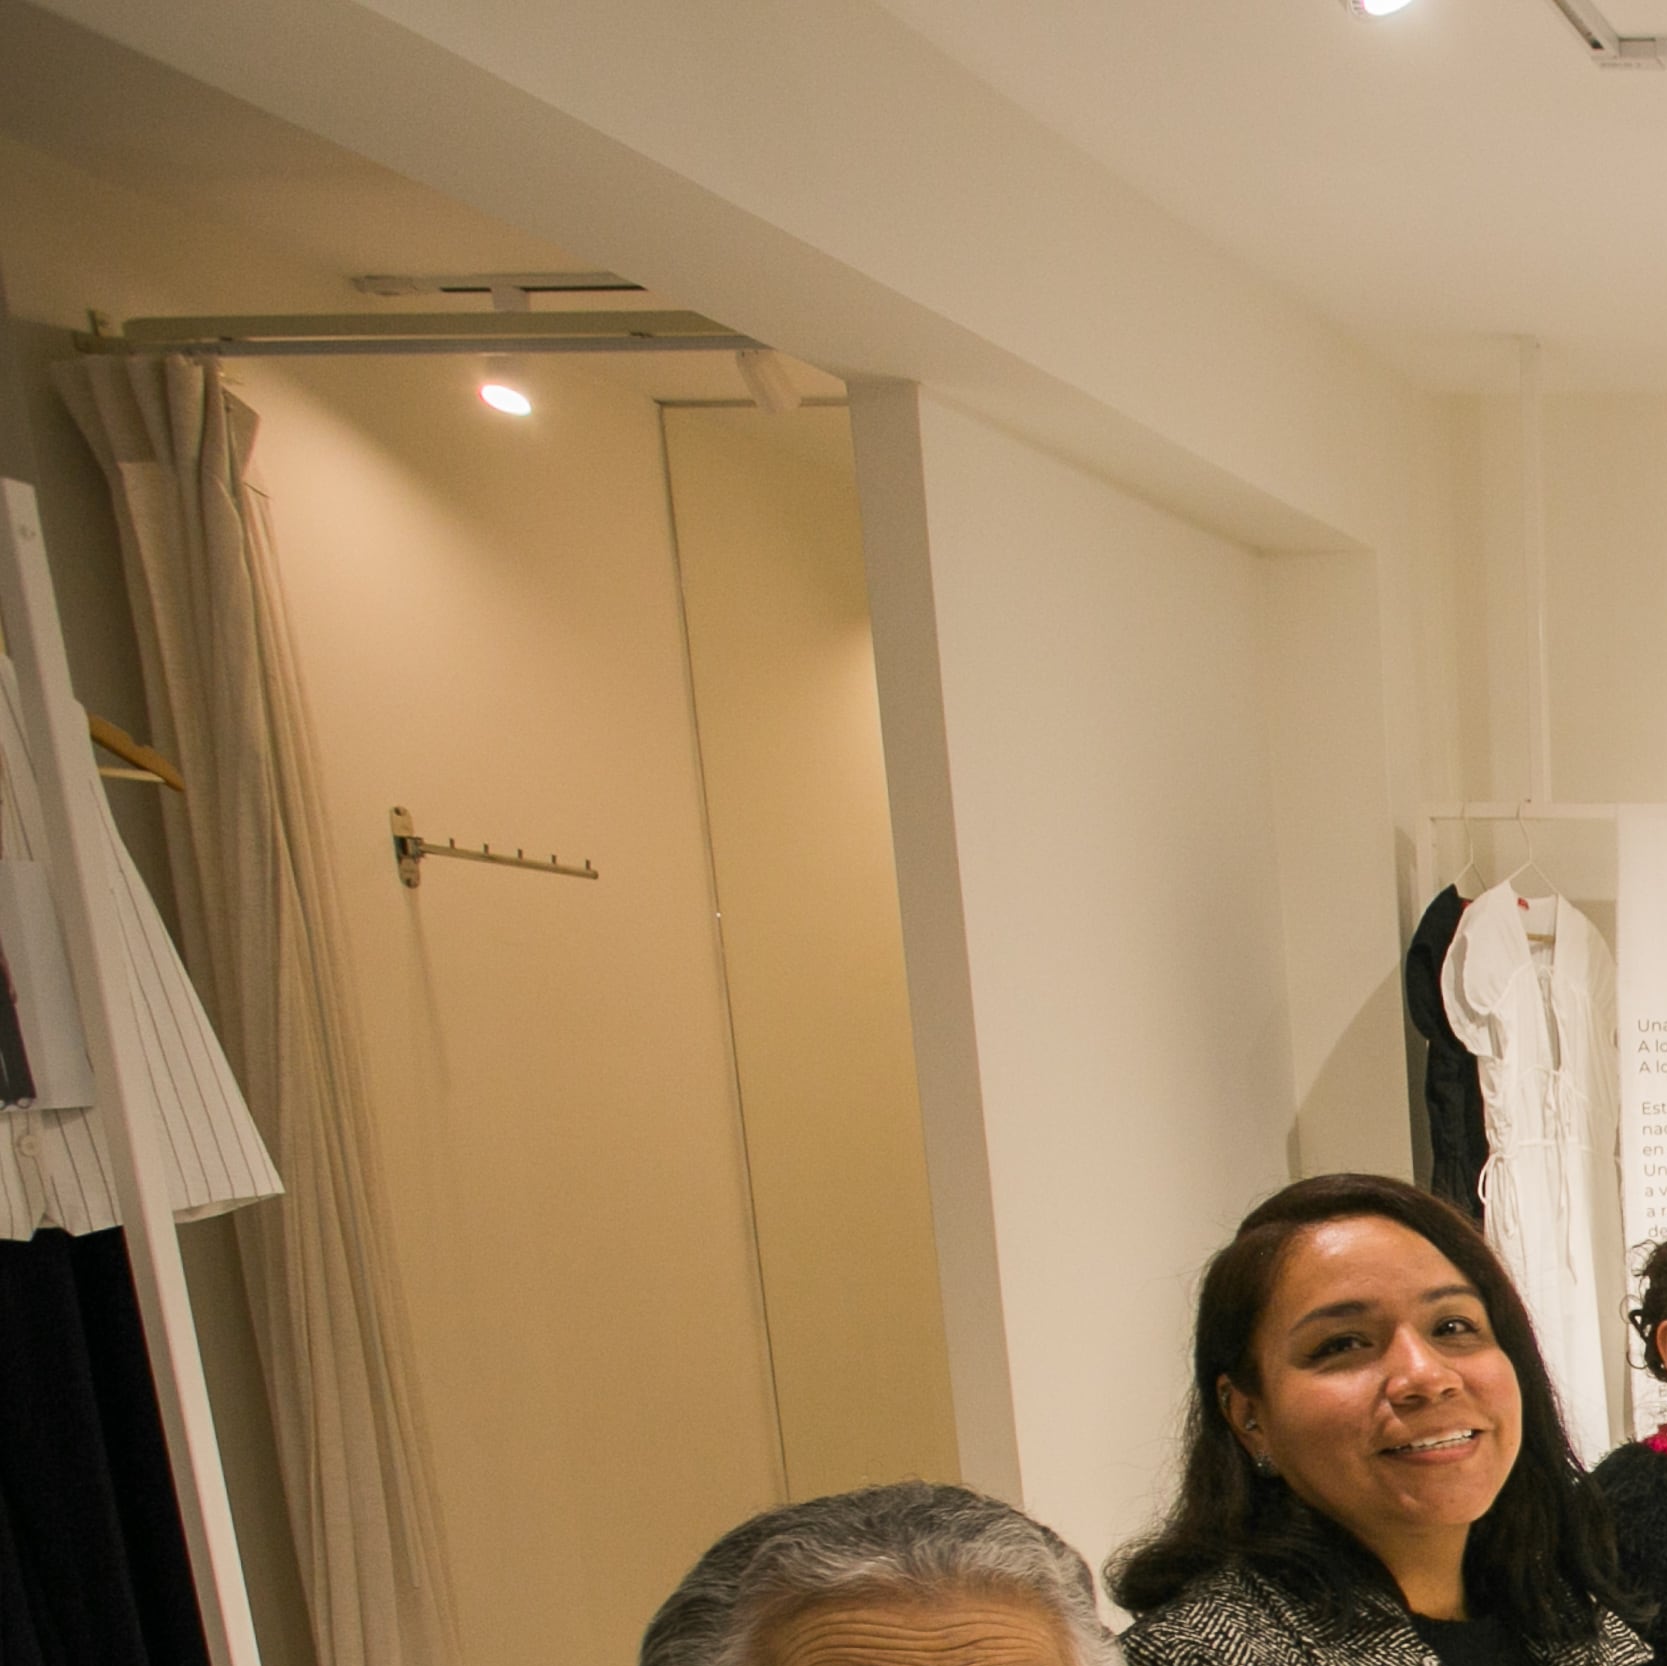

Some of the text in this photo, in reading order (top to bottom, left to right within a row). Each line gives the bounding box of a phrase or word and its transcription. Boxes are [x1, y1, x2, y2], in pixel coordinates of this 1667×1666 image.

[1638, 1040, 1650, 1053] A
[1639, 1061, 1651, 1073] A
[1642, 1145, 1664, 1156] en
[1644, 1186, 1654, 1197] a
[1646, 1207, 1656, 1217] a
